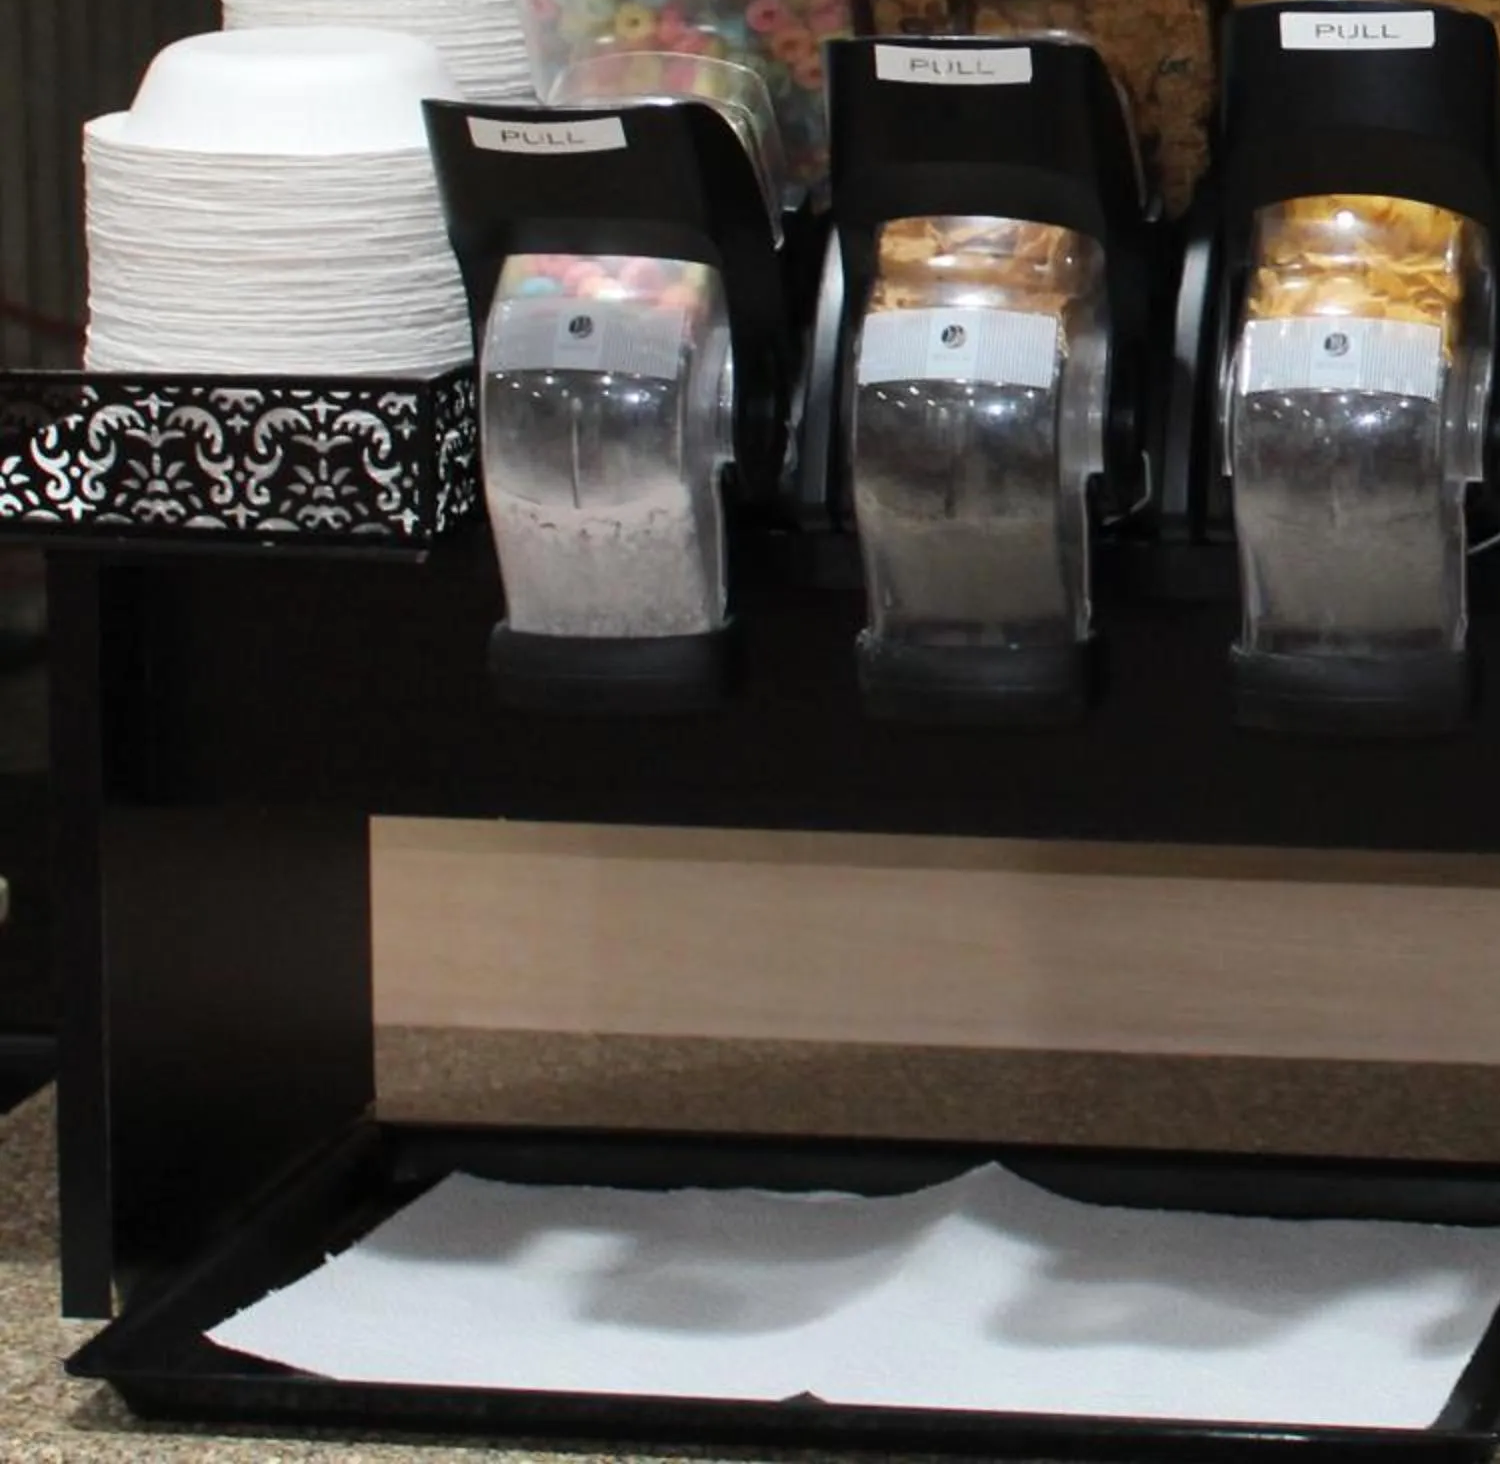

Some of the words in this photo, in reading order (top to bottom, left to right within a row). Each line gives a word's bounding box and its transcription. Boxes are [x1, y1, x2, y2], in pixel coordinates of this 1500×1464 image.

[1314, 23, 1402, 40] PULL
[909, 57, 996, 76] PULL
[501, 128, 585, 146] PULL
